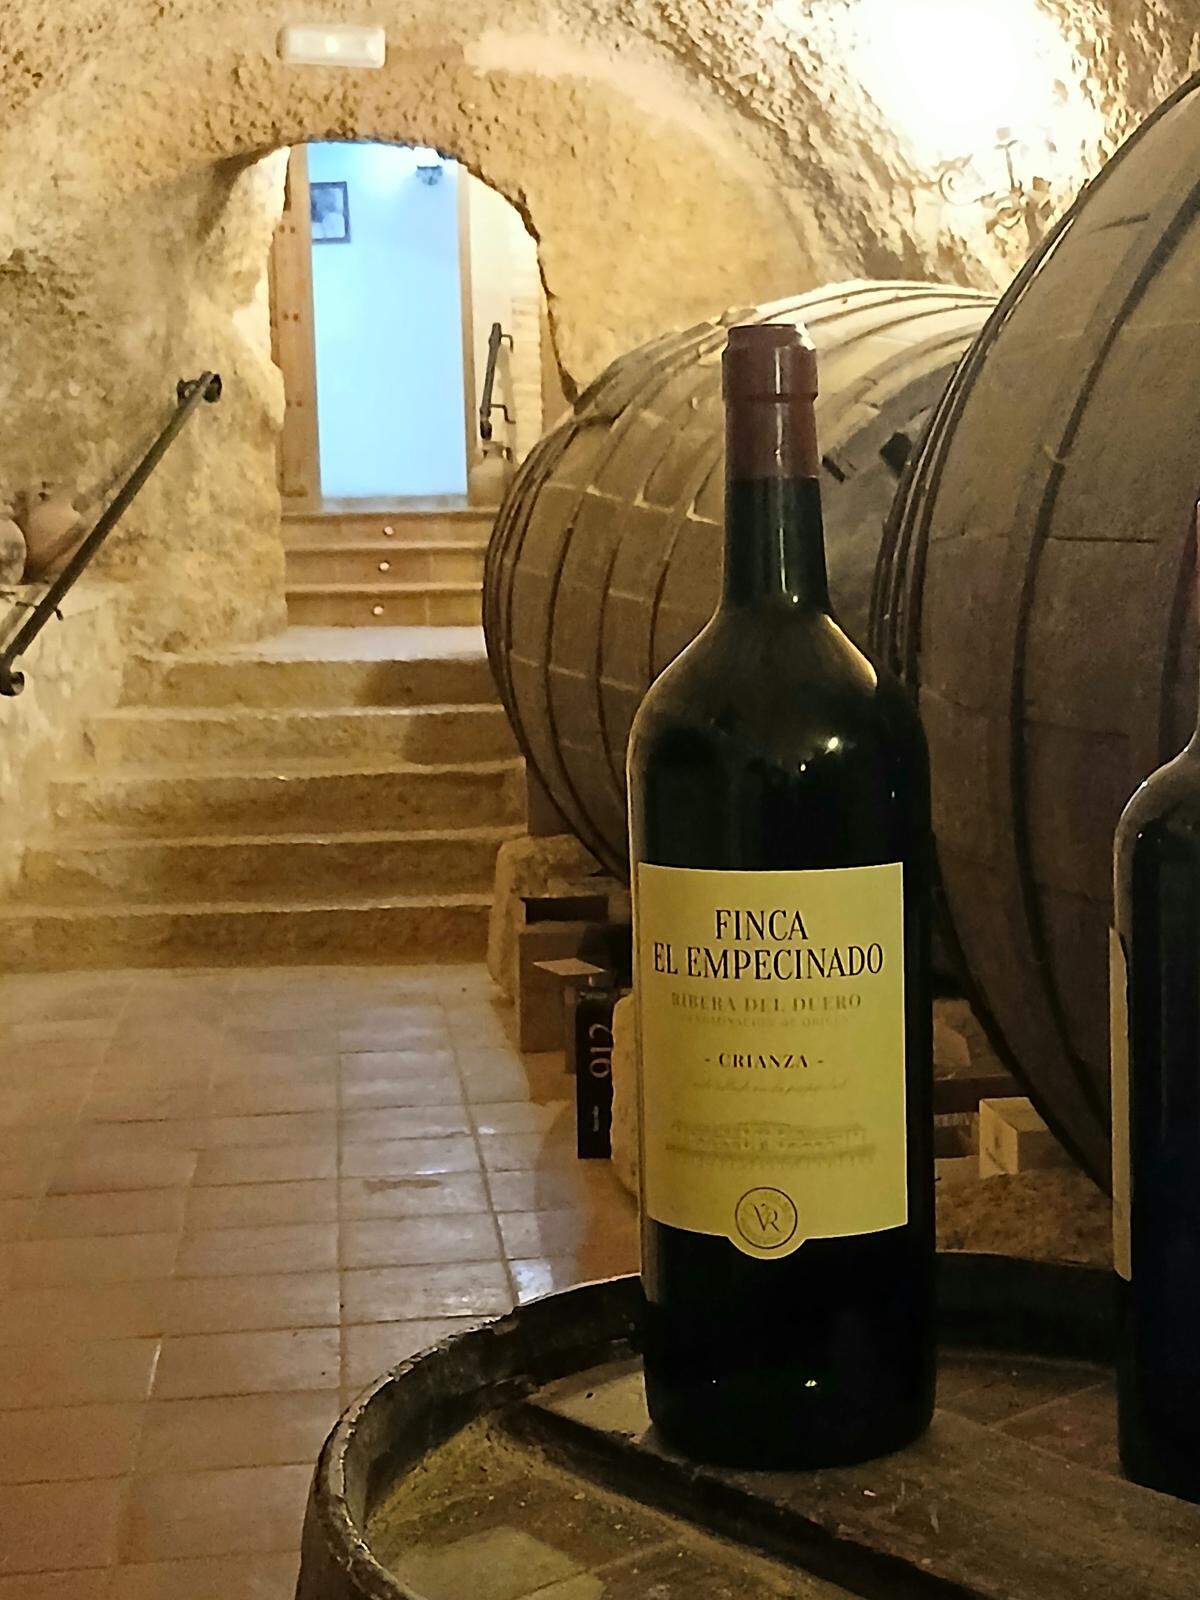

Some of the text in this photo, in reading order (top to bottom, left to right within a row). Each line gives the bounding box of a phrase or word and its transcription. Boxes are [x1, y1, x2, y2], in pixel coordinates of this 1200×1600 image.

[715, 909, 808, 941] FINCA
[653, 942, 883, 980] EL EMPECINADO
